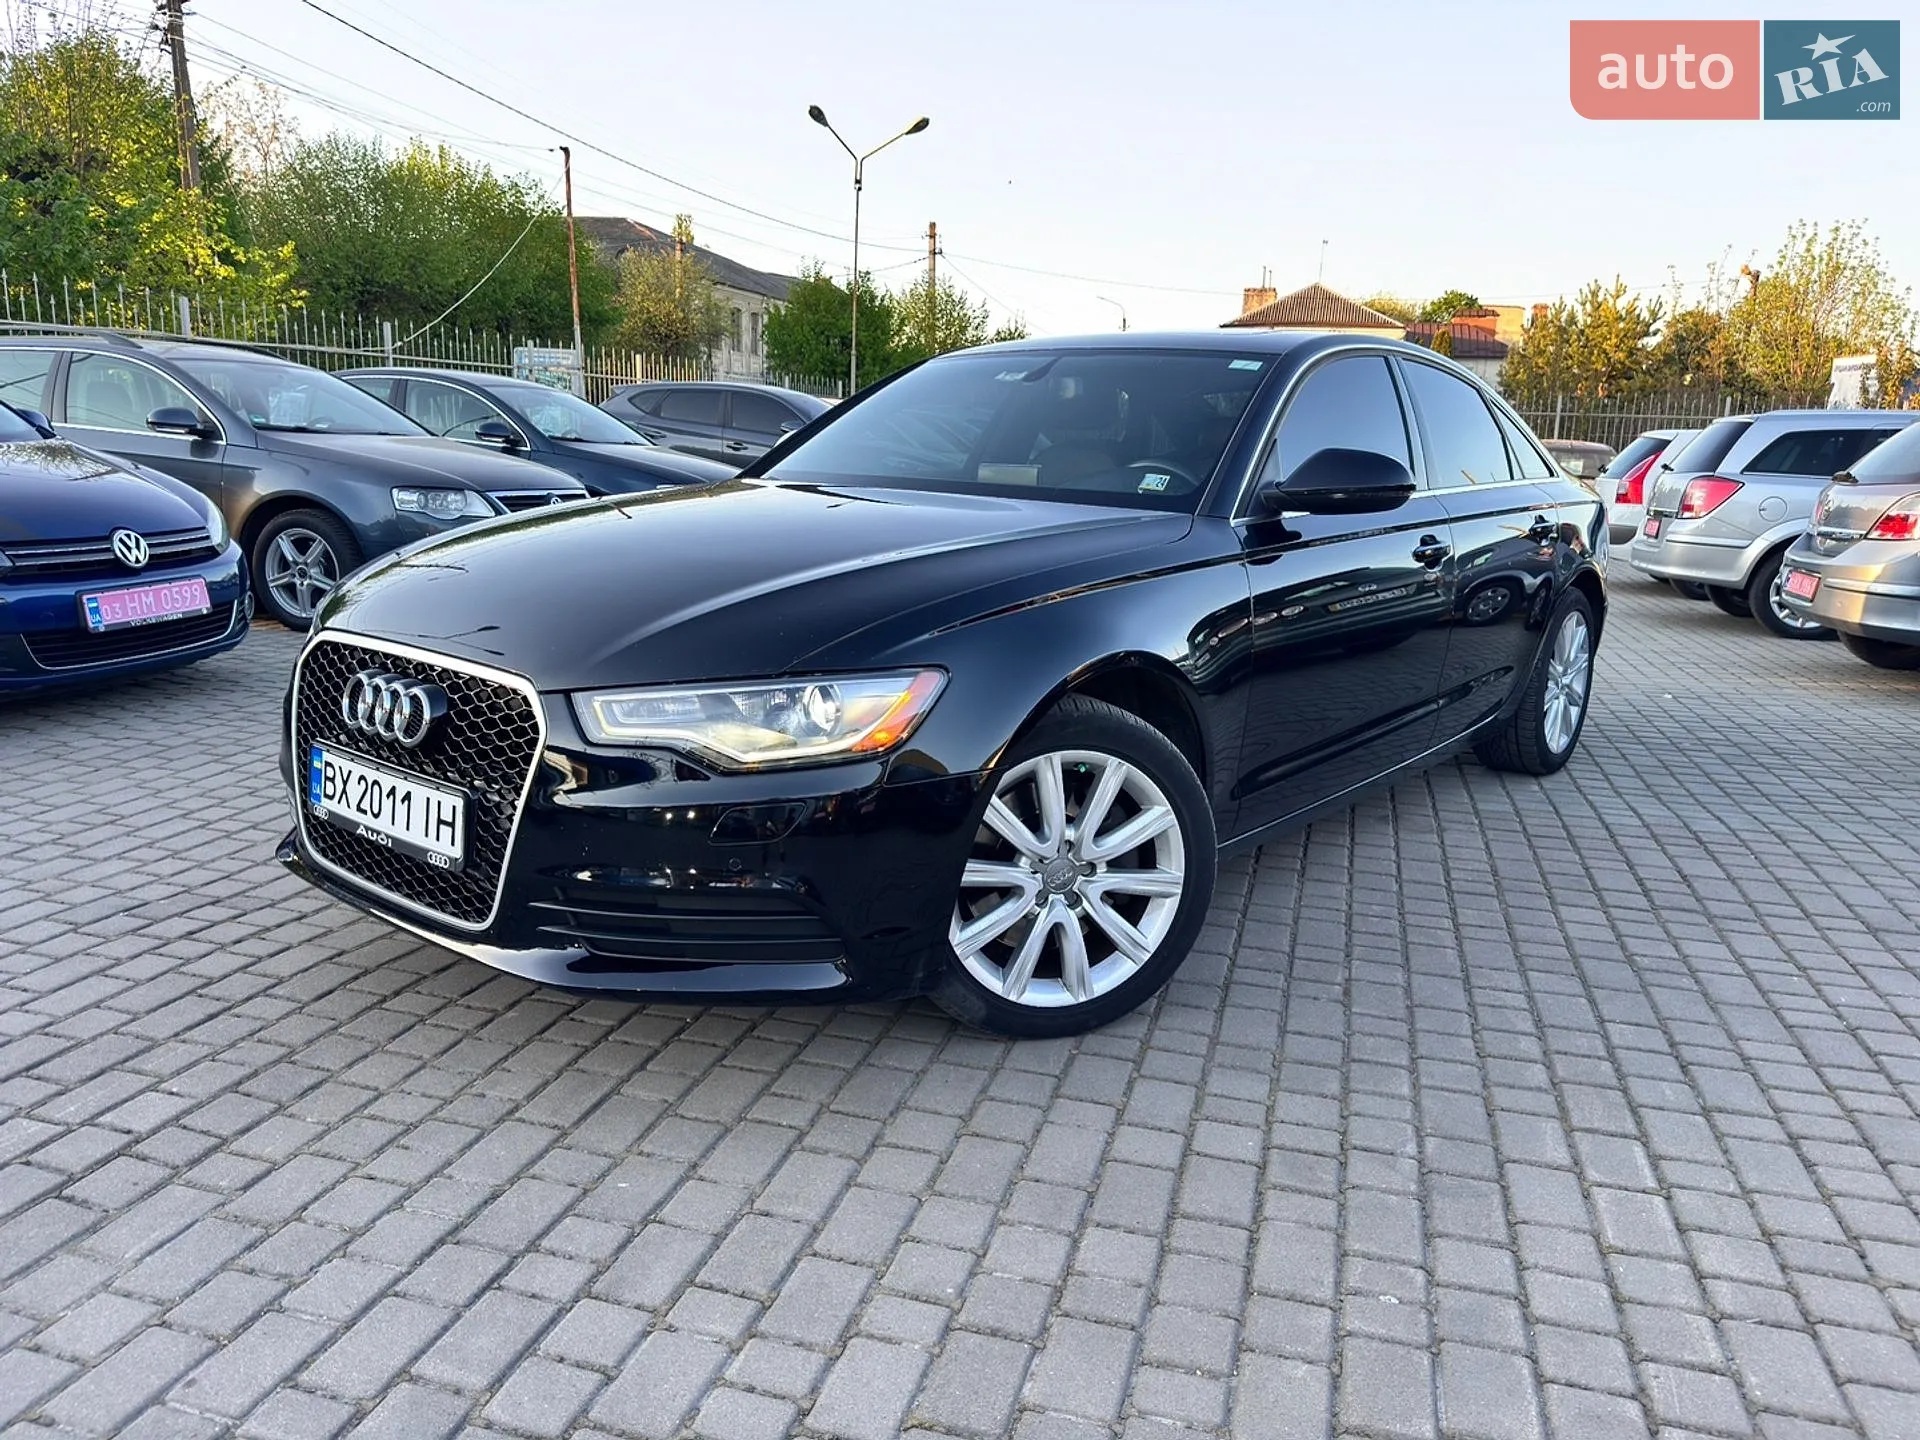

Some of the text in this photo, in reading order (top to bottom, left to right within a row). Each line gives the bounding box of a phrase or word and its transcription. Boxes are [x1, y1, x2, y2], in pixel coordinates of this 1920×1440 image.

[102, 584, 201, 620] 03 HM 0599
[91, 613, 102, 623] UA
[312, 782, 321, 795] UA
[323, 760, 456, 847] BX 2011 IH
